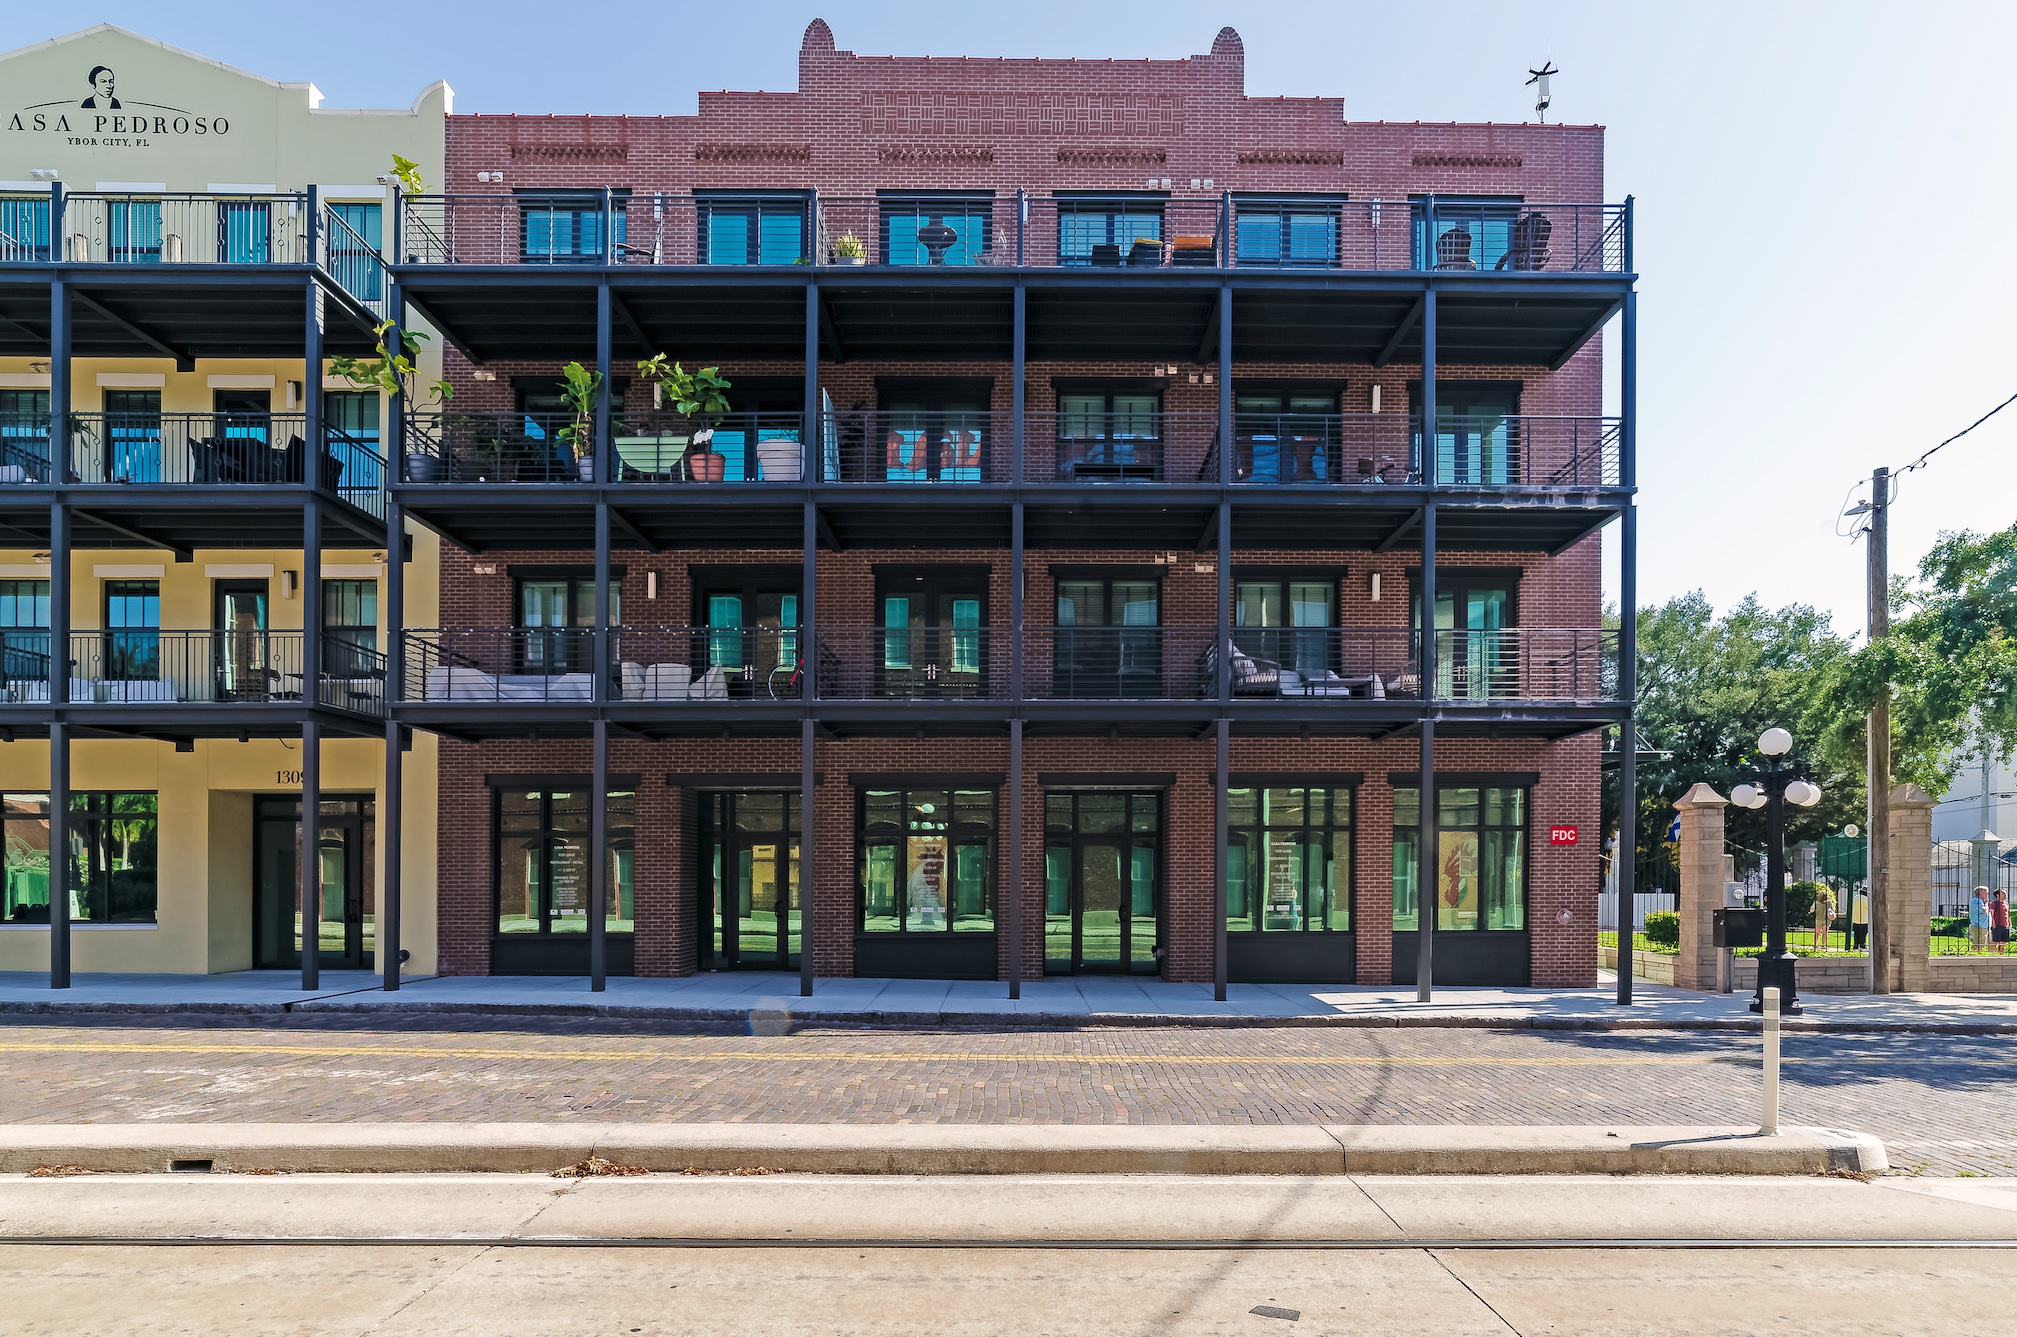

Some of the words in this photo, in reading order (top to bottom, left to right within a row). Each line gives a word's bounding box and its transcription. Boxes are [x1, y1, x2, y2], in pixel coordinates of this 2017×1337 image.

[7, 113, 72, 132] ASA
[93, 115, 230, 135] PEDROSO
[67, 137, 98, 146] YBOR
[102, 138, 131, 148] CITY,
[136, 139, 150, 147] FL
[1552, 830, 1575, 841] FDC
